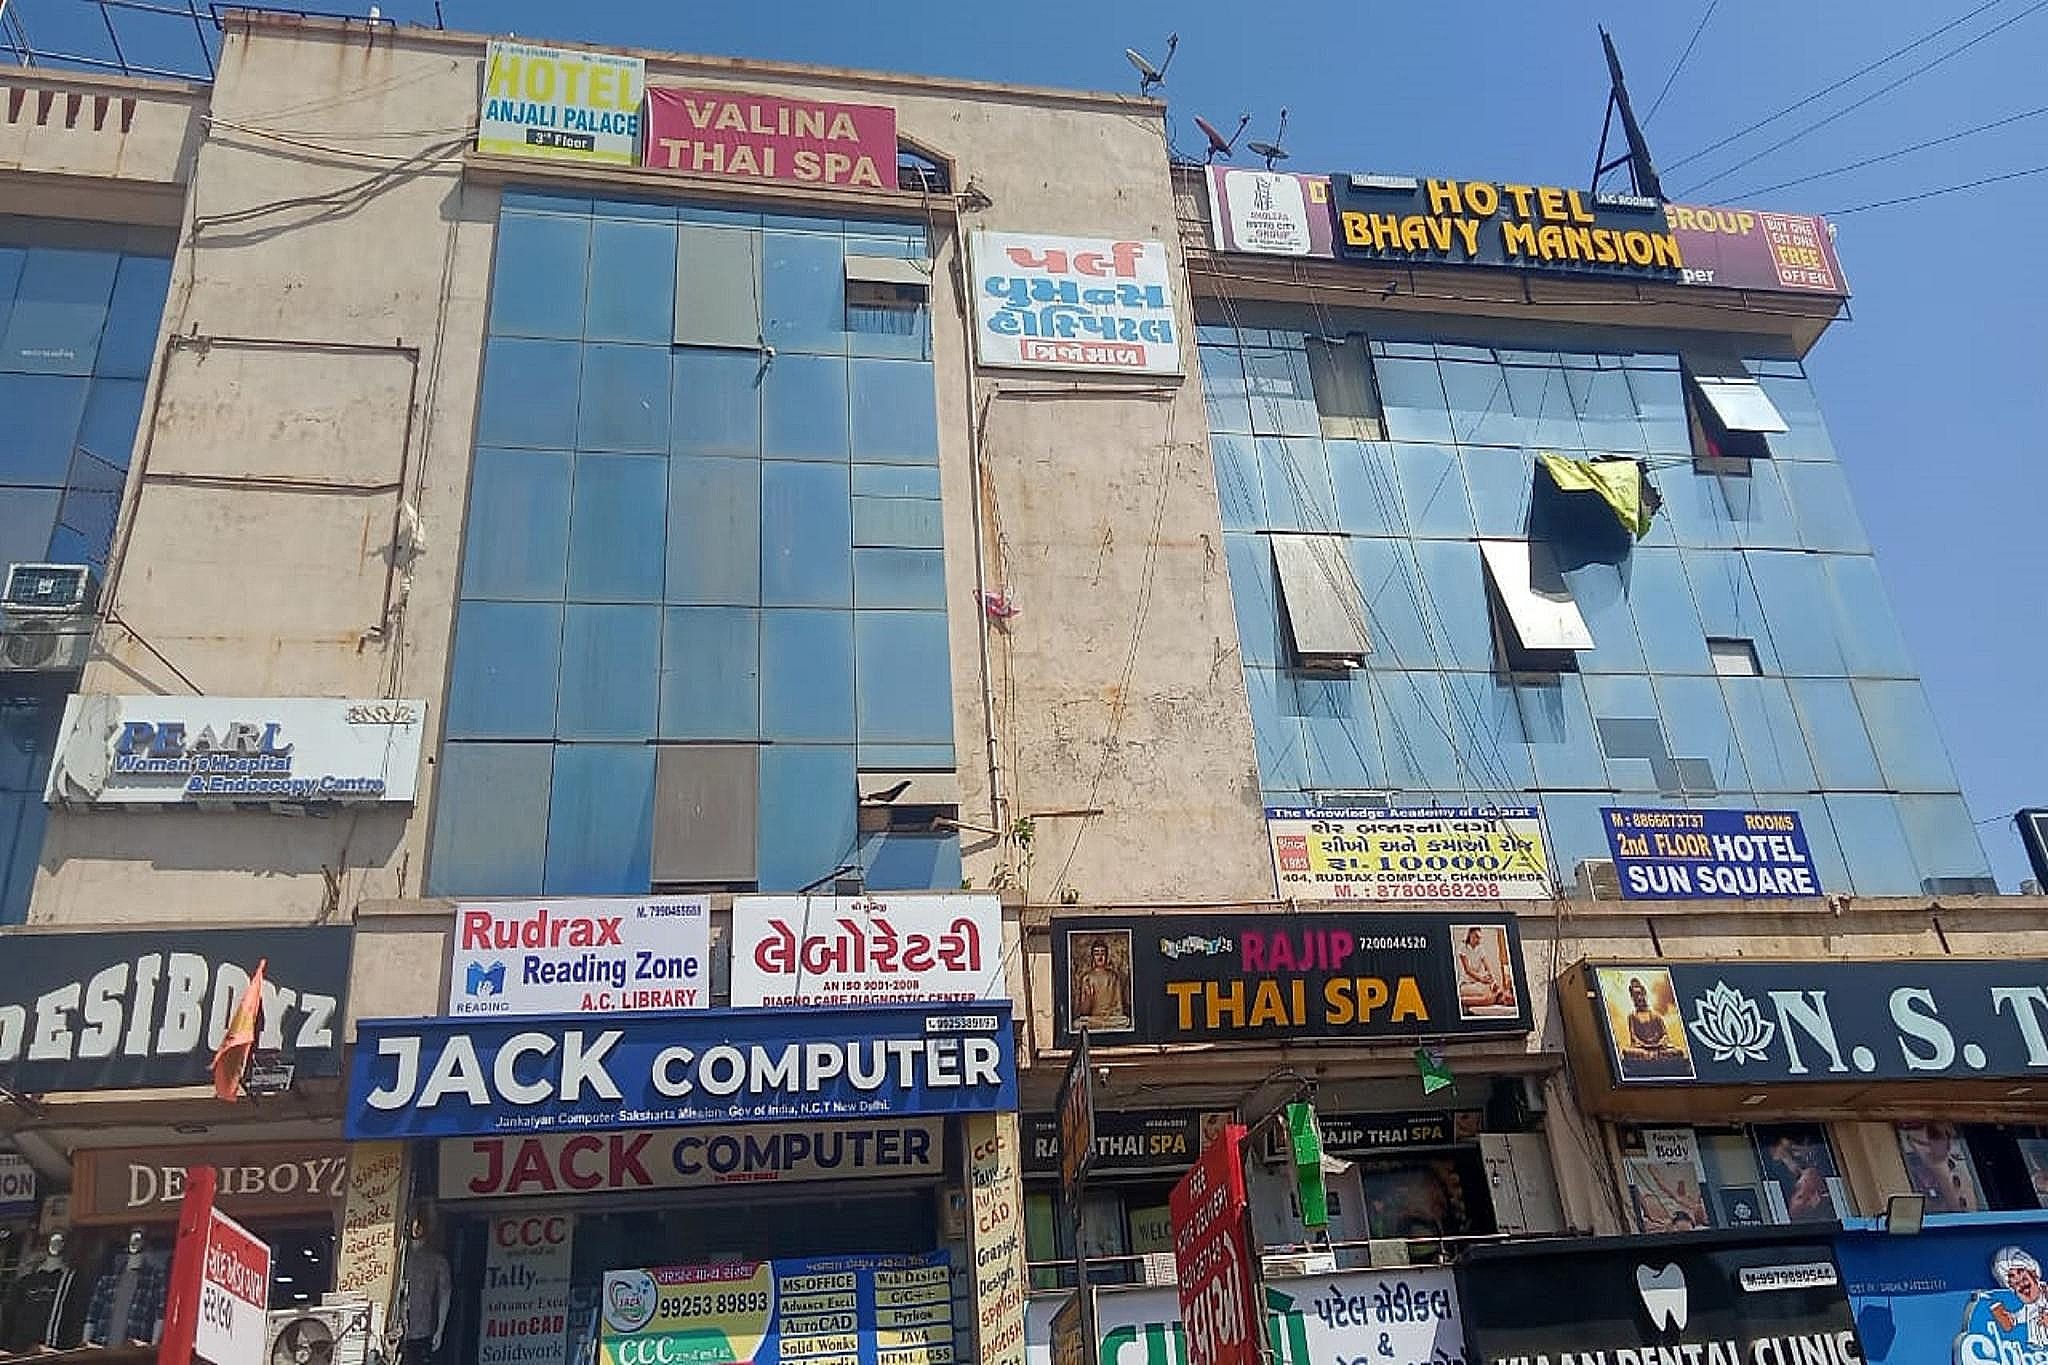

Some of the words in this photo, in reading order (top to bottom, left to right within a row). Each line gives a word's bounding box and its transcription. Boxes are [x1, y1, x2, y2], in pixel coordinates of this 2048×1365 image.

[487, 52, 640, 112] HOTEL
[486, 98, 557, 127] ANJALI
[564, 107, 638, 137] PALACE
[684, 99, 860, 143] VALINA
[659, 138, 775, 177] THAI
[792, 150, 882, 188] SPA
[1427, 178, 1596, 223] HOTEL
[1341, 210, 1479, 256] BHAVY
[1502, 221, 1682, 268] MANSION
[1777, 246, 1820, 268] FREE
[113, 721, 296, 754] PEARL
[212, 755, 292, 772] Hospital
[187, 777, 207, 792] &
[209, 777, 319, 794] Endoscopy
[1272, 808, 1304, 818] The
[1305, 808, 1385, 819] Knowledge
[1390, 807, 1456, 819] Academy
[1459, 807, 1473, 817] of
[1744, 815, 1794, 831] ROOMS
[1617, 833, 1649, 856] 2nd
[1655, 833, 1712, 857] FLOOR
[1711, 835, 1805, 863] HOTEL
[1315, 873, 1373, 883] RUDRAX
[1628, 866, 1693, 893] SUN
[1697, 867, 1816, 896] SQUARE
[462, 909, 624, 951] Rudrax
[754, 917, 982, 976] લેબોરેટરી
[1239, 928, 1354, 973] RAJIP
[522, 953, 627, 988] Reading
[635, 951, 699, 980] Zone
[581, 992, 615, 1011] A.C.
[621, 989, 698, 1009] LIBRARY
[823, 981, 840, 991] AN
[842, 981, 862, 991] ISO
[456, 1002, 510, 1014] READING
[1166, 978, 1307, 1030] THAI
[1324, 976, 1431, 1025] SPA
[366, 1030, 625, 1109] JACK
[651, 1037, 1003, 1096] COMPUTER
[557, 1111, 614, 1124] Computer
[728, 1105, 751, 1117] Gov
[833, 1100, 856, 1111] New
[975, 1136, 1005, 1160] CCC
[1097, 1135, 1144, 1156] THAI
[1150, 1133, 1187, 1155] SPA
[1368, 1127, 1408, 1144] THAI
[1411, 1126, 1444, 1140] SPA
[468, 1132, 655, 1194] JACK
[672, 1129, 931, 1175] COMPUTER
[1655, 1145, 1689, 1160] Body
[496, 1216, 565, 1247] CCC
[979, 1202, 1009, 1232] CAD
[783, 1275, 853, 1292] MS-OFFICE
[660, 1296, 713, 1318] 99253
[716, 1291, 767, 1314] 89893
[1315, 1283, 1368, 1329] પટેલ
[486, 1316, 565, 1338] AutoCAD
[900, 1329, 929, 1343] JAVA
[618, 1336, 674, 1365] CCC
[782, 1340, 813, 1355] Solid
[1378, 1332, 1395, 1358] &
[1754, 1330, 1862, 1365] CLINIC
